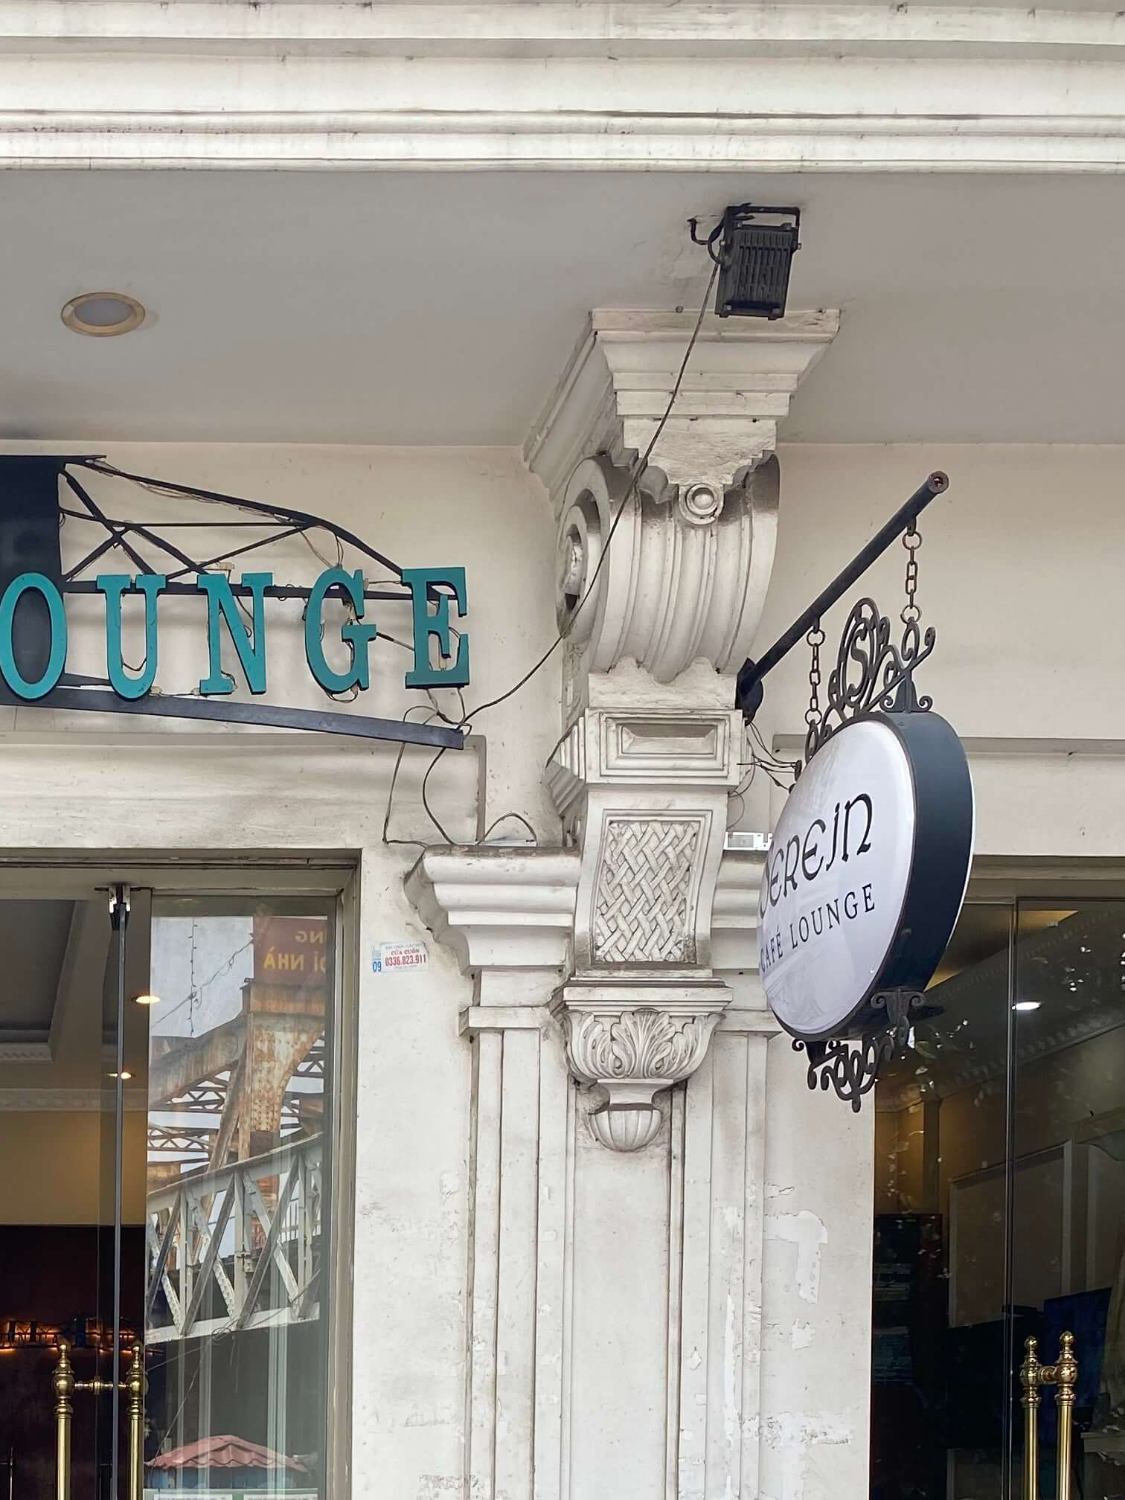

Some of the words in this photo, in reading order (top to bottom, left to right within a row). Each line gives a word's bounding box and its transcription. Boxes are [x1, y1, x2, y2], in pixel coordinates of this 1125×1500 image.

[760, 925, 784, 973] CAFÉ
[789, 883, 875, 949] LOUNGE
[384, 954, 426, 967] 0336.823.911
